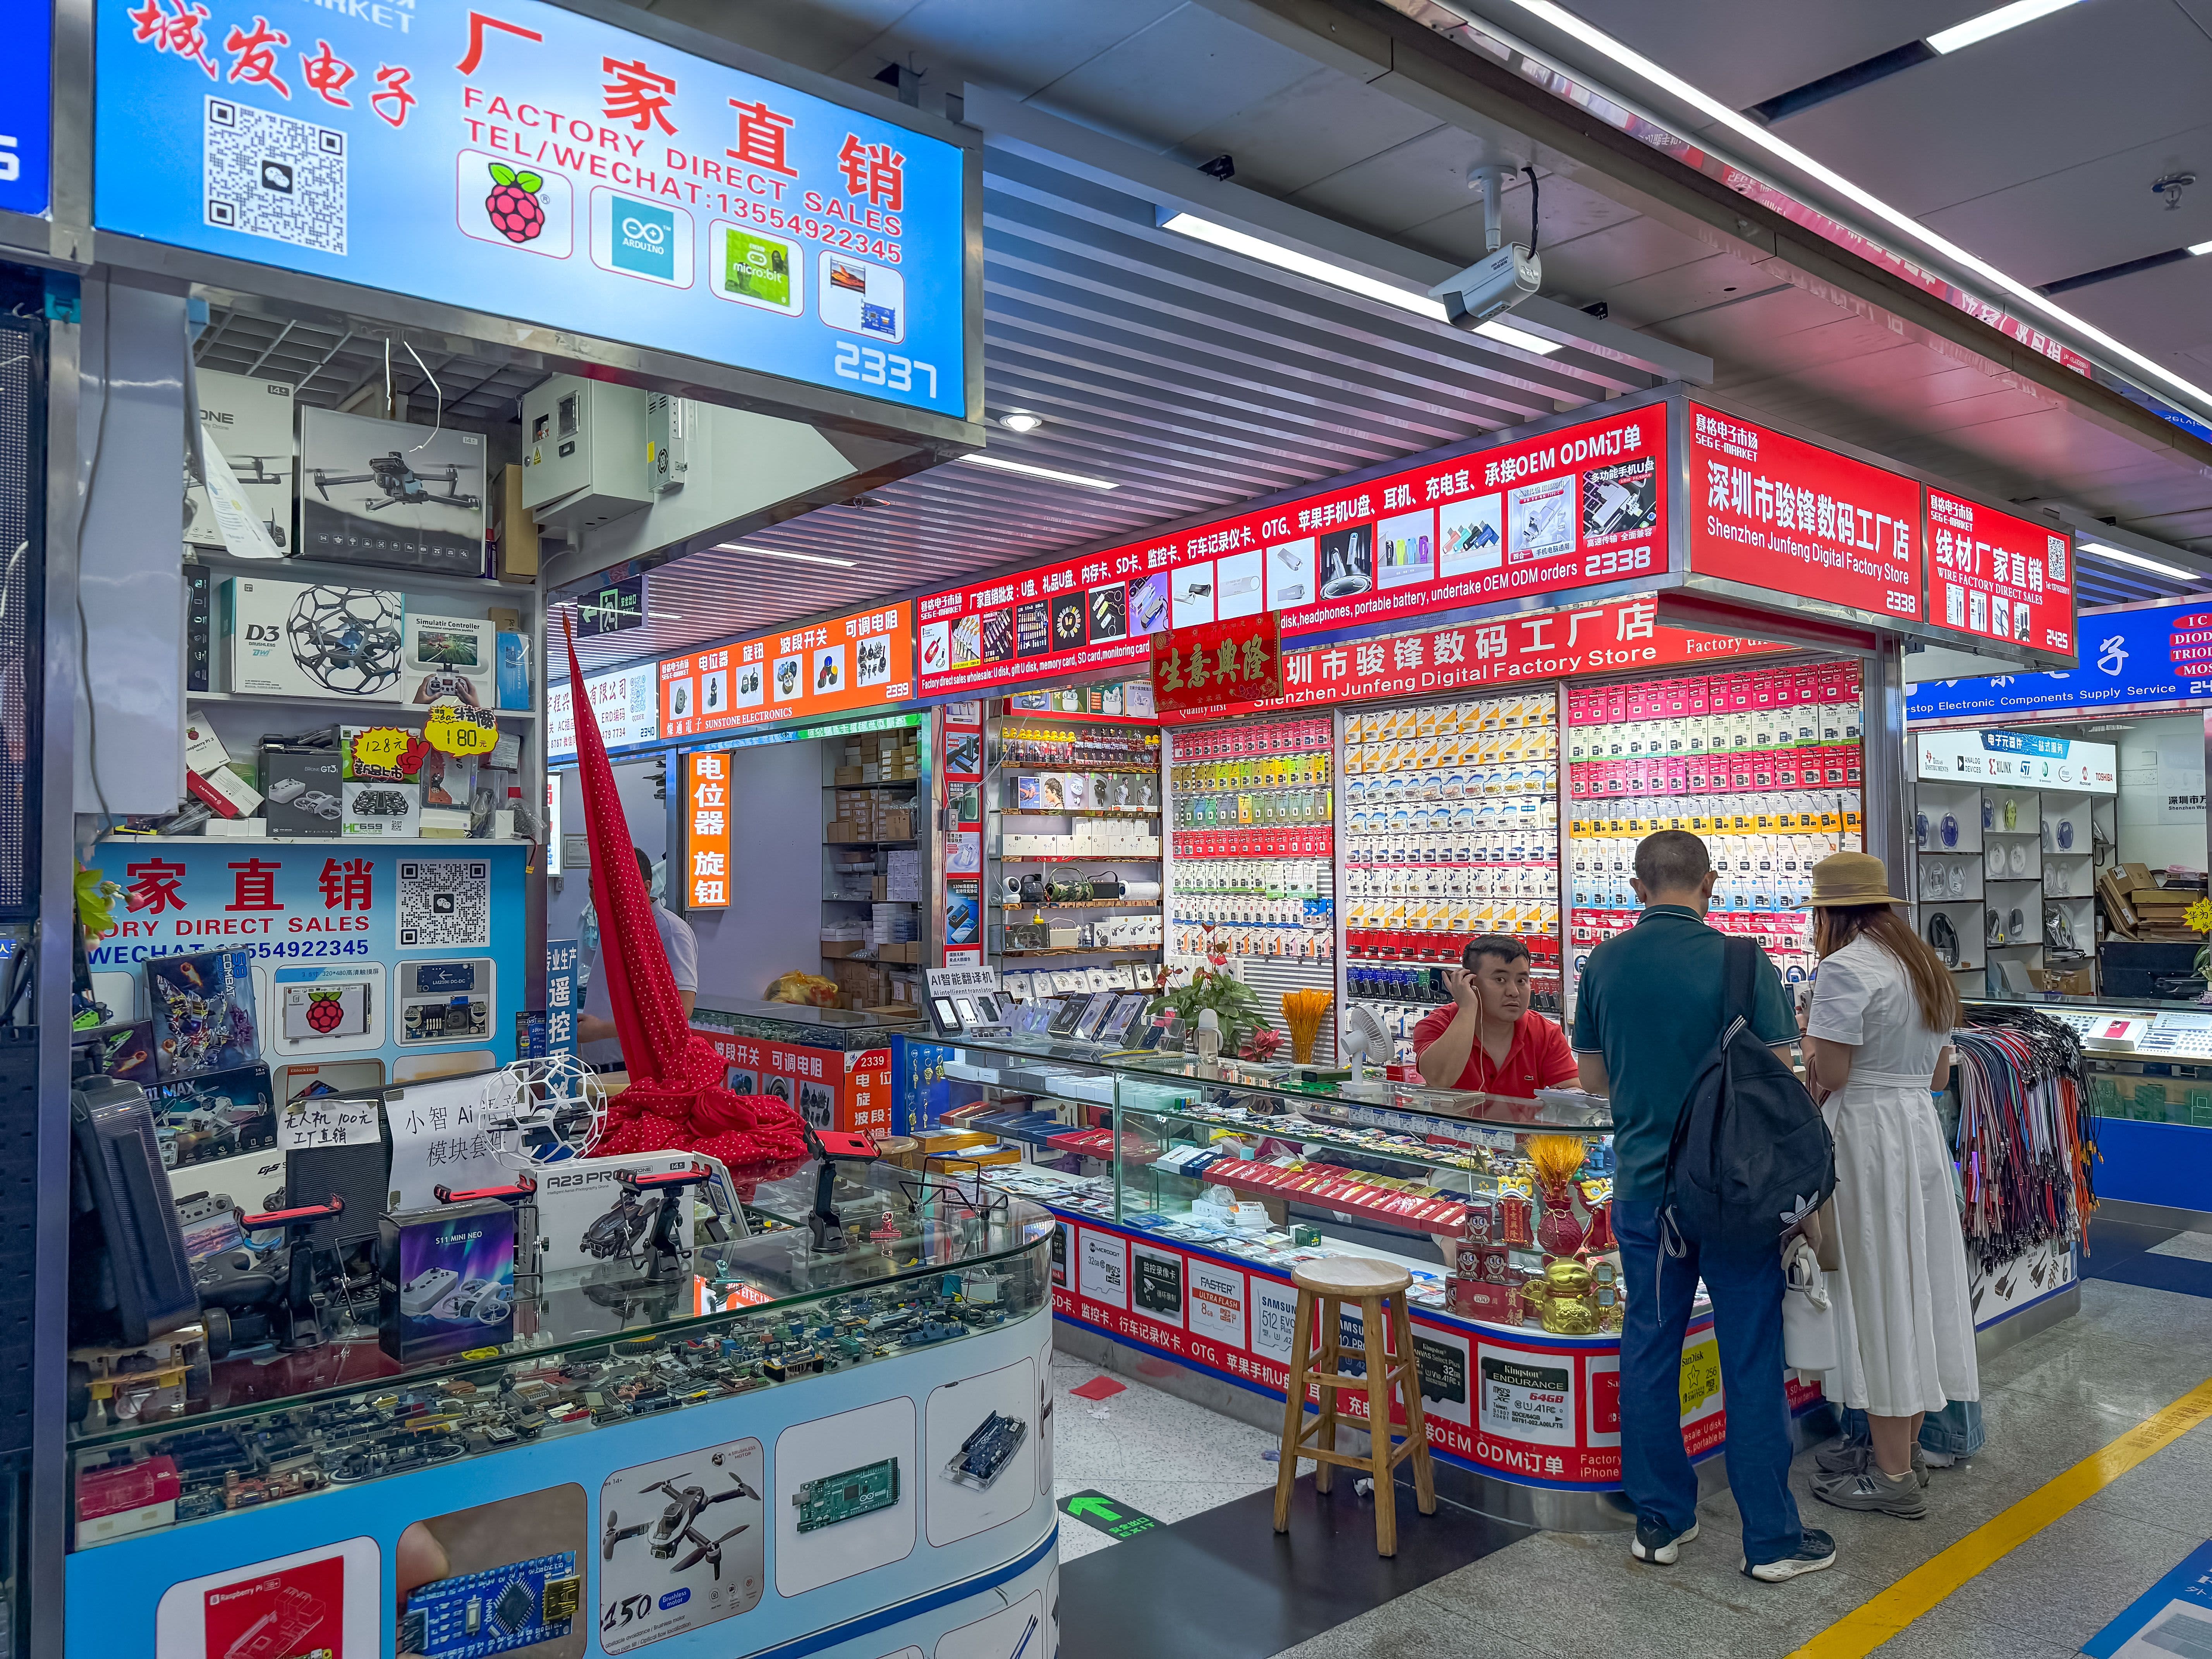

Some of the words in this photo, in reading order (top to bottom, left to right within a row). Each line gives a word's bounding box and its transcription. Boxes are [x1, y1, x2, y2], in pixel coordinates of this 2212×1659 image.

[130, 0, 417, 127] 城发电子
[455, 11, 905, 212] 厂家直销
[464, 87, 644, 157] FACTORY
[667, 146, 787, 201] DIRECT
[804, 191, 902, 236] SALES
[464, 118, 902, 263] TEL/WECHAT:13554922345
[622, 237, 664, 255] ARDUINO
[733, 262, 782, 283] micro:bit
[835, 341, 937, 399] 2337
[1696, 413, 1758, 450] 赛格电子市场
[1695, 433, 1713, 448] SEG
[1715, 440, 1757, 462] E-MARKET
[1590, 458, 1654, 484] 多功能手机U盘
[1707, 459, 1909, 562] 深圳市骏锋数码工厂店
[1930, 495, 1973, 522] 赛格电子市场
[1931, 510, 1943, 523] SEG
[1944, 514, 1973, 532] E-MARKET
[1536, 543, 1570, 556] 手机电脑通用
[1707, 515, 1765, 548] Shenzhen
[1767, 531, 1810, 563] Junfeng
[1812, 543, 1844, 568] Digital
[1846, 552, 1882, 581] Factory
[1884, 562, 1909, 584] Store
[1585, 546, 1650, 577] 2338
[1936, 527, 2042, 592] 线材厂家直销
[1355, 596, 1391, 618] portable
[1393, 592, 1429, 613] battery,
[1431, 581, 1481, 601] undertake
[1484, 574, 1508, 590] OEM
[1511, 569, 1538, 586] ODM
[1540, 563, 1577, 580] orders
[1937, 567, 1957, 582] WIRE
[1959, 572, 1994, 592] FACTORY
[1996, 583, 2022, 599] DIRECT
[2023, 591, 2043, 605] SALES
[621, 594, 636, 607] 安全出口
[921, 592, 962, 613] 赛格电子市场
[1886, 590, 1915, 614] 2338
[921, 611, 932, 620] SEG
[932, 605, 962, 617] E-MARKET
[245, 624, 280, 642] D3
[416, 618, 447, 627] Simulatir
[448, 621, 480, 629] Controller
[699, 651, 728, 671] 电位器
[743, 642, 764, 662] 旋钮
[780, 627, 828, 654] 波段开关
[845, 609, 898, 638] 可调电阻
[1686, 637, 1741, 654] Factory
[2047, 628, 2068, 649] 2425
[922, 678, 938, 689] Factory
[939, 675, 953, 686] direct
[953, 674, 966, 684] sales
[967, 670, 993, 682] wholesale:
[1012, 665, 1020, 676] gift
[1039, 658, 1061, 671] memory
[1078, 651, 1087, 664] SD
[1159, 634, 1270, 692] 生意興隆
[1341, 675, 1415, 703] Junfeng
[1420, 665, 1487, 691] Digital
[1493, 654, 1580, 678] Factory
[1587, 644, 1656, 666] Store
[589, 678, 626, 706] 有限公司
[886, 682, 909, 698] 2339
[1938, 698, 1995, 710] Electronic
[2001, 691, 2073, 709] Components
[2080, 688, 2121, 701] Supply
[2127, 684, 2176, 696] Service
[454, 706, 495, 730] 特價
[602, 708, 625, 723] ERD编码
[705, 715, 741, 730] SUNSTONE
[742, 707, 792, 724] ELECTRONICS
[447, 729, 477, 747] 180
[613, 728, 625, 738] 7734
[641, 726, 654, 737] 2340
[1988, 734, 2022, 749] 电子元器件
[2032, 739, 2063, 754] 一站式服务
[354, 758, 403, 780] 新品上市
[1997, 761, 2011, 774] XILINX
[2096, 772, 2113, 781] TOSHIBA
[694, 755, 725, 836] 电位器
[694, 851, 726, 904] 旋钮
[176, 918, 274, 936] DIRECT
[288, 915, 370, 933] SALES
[223, 953, 237, 998] COMBAT
[932, 971, 993, 986] AI智能翻译机
[715, 1041, 759, 1066] 波段开关
[772, 1051, 822, 1078] 可调电阻
[861, 1056, 884, 1067] 2339
[163, 1080, 196, 1098] MAX
[285, 1111, 331, 1128] 无人机
[338, 1111, 373, 1125] 100元
[294, 1128, 347, 1144] 工厂直销
[426, 1128, 507, 1167] 模块套件
[257, 1163, 281, 1175] GPS
[547, 1174, 583, 1189] A23
[435, 1236, 448, 1244] S11
[450, 1233, 466, 1243] MINI
[467, 1231, 483, 1240] NEO
[1144, 1261, 1176, 1280] 监控录像卡
[1200, 1276, 1232, 1295] FASTER
[1199, 1291, 1217, 1304] ULTRA
[1219, 1296, 1238, 1309] FLASH
[1262, 1310, 1278, 1329] 512
[1280, 1324, 1291, 1334] Plus
[1423, 1343, 1446, 1355] Kingston
[1682, 1351, 1704, 1367] SanDisk
[1493, 1373, 1565, 1390] ENDURANCE
[1505, 1365, 1539, 1379] Kingston
[1705, 1366, 1717, 1379] 256
[1530, 1392, 1564, 1403] 64GB
[1693, 1435, 1718, 1452] portable
[735, 1451, 752, 1459] MOTOR
[1477, 1441, 1564, 1475] ODM订单
[1581, 1467, 1619, 1478] iPhone
[1109, 1517, 1149, 1533] 安全出口
[1118, 1522, 1154, 1537] EXIT
[220, 1588, 254, 1602] Raspberry
[663, 1590, 687, 1603] Brushless
[667, 1597, 683, 1607] motor
[605, 1637, 625, 1649] obstacle
[626, 1627, 650, 1642] avoidance
[641, 1632, 657, 1644] Optical
[667, 1621, 691, 1635] localization
